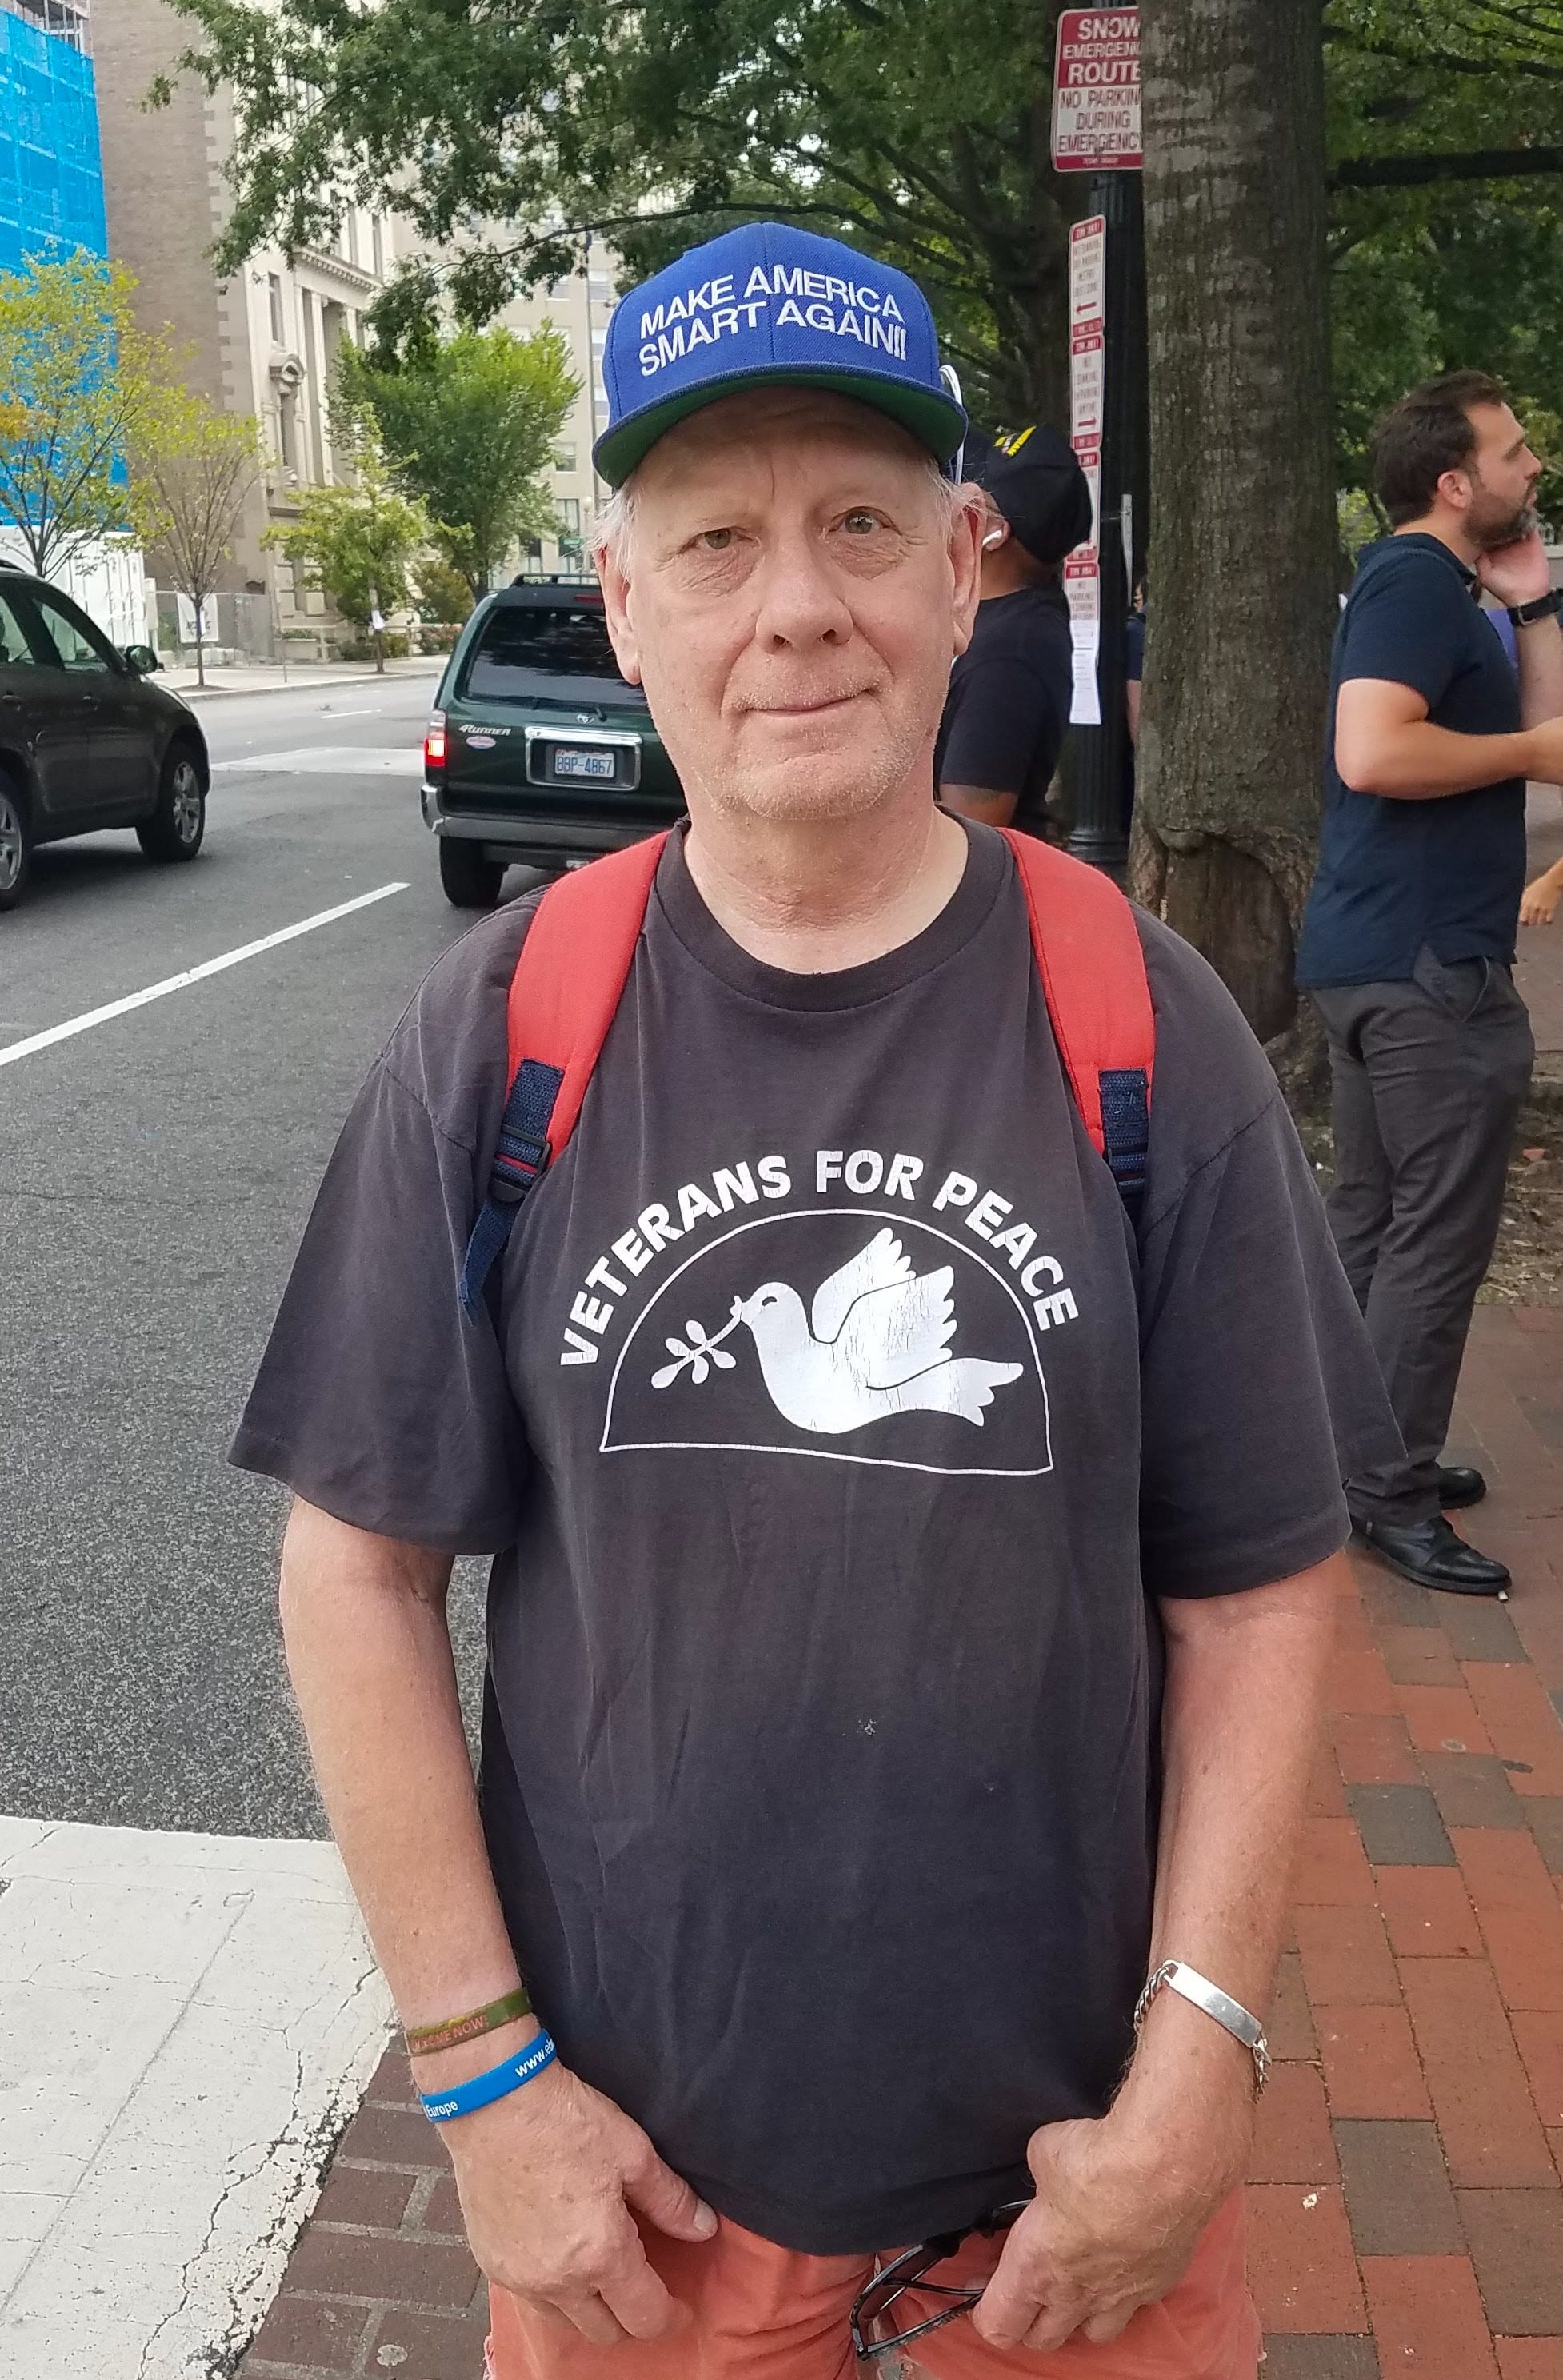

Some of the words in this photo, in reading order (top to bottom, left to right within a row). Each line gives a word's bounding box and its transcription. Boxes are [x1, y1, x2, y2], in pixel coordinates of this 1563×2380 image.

[1077, 17, 1140, 39] SNOW
[1068, 60, 1141, 85] ROUTE
[1061, 90, 1081, 109] NO
[1088, 89, 1141, 107] PARKIN
[1076, 110, 1130, 130] DURING
[1058, 132, 1141, 152] EMERGENC
[641, 274, 735, 339] MAKE
[743, 265, 905, 324] AMERICA
[639, 301, 766, 377] SMART
[561, 1156, 791, 1365] VETERANS
[816, 1150, 924, 1200] FOR
[932, 1170, 1079, 1330] PEACE
[425, 2100, 458, 2117] Europe
